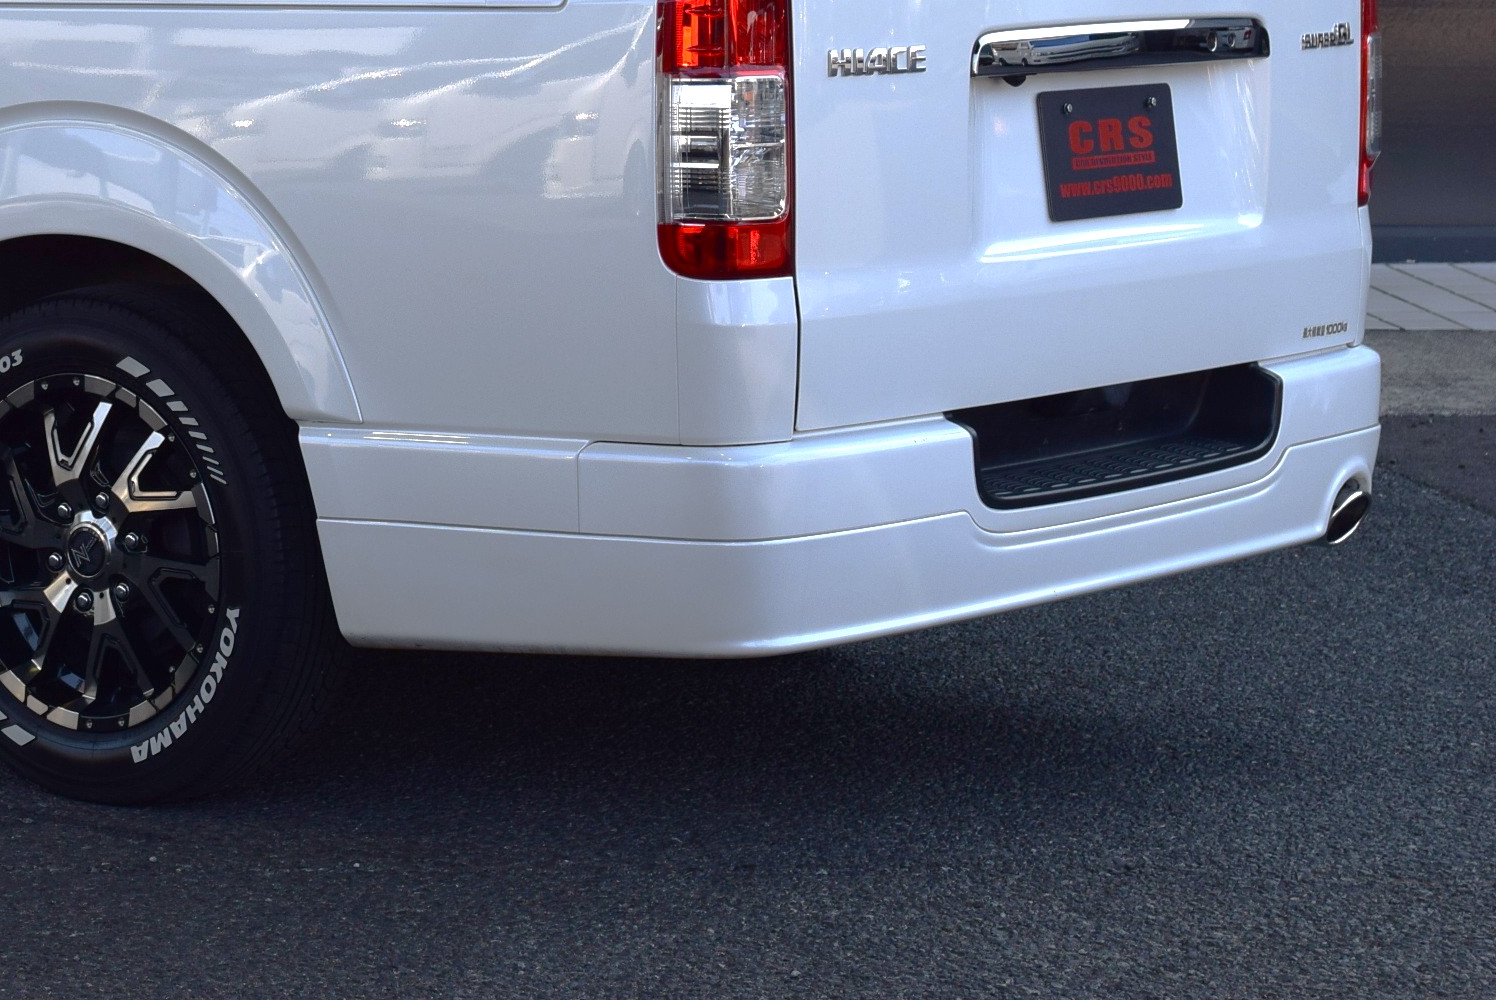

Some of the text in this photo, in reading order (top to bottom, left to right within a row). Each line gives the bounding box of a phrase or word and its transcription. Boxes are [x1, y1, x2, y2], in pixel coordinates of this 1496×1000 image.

[827, 44, 927, 78] HIACE
[1068, 115, 1154, 155] CRS
[1060, 173, 1173, 198] www.crs9000.com
[130, 607, 240, 764] YOKOHAMA
